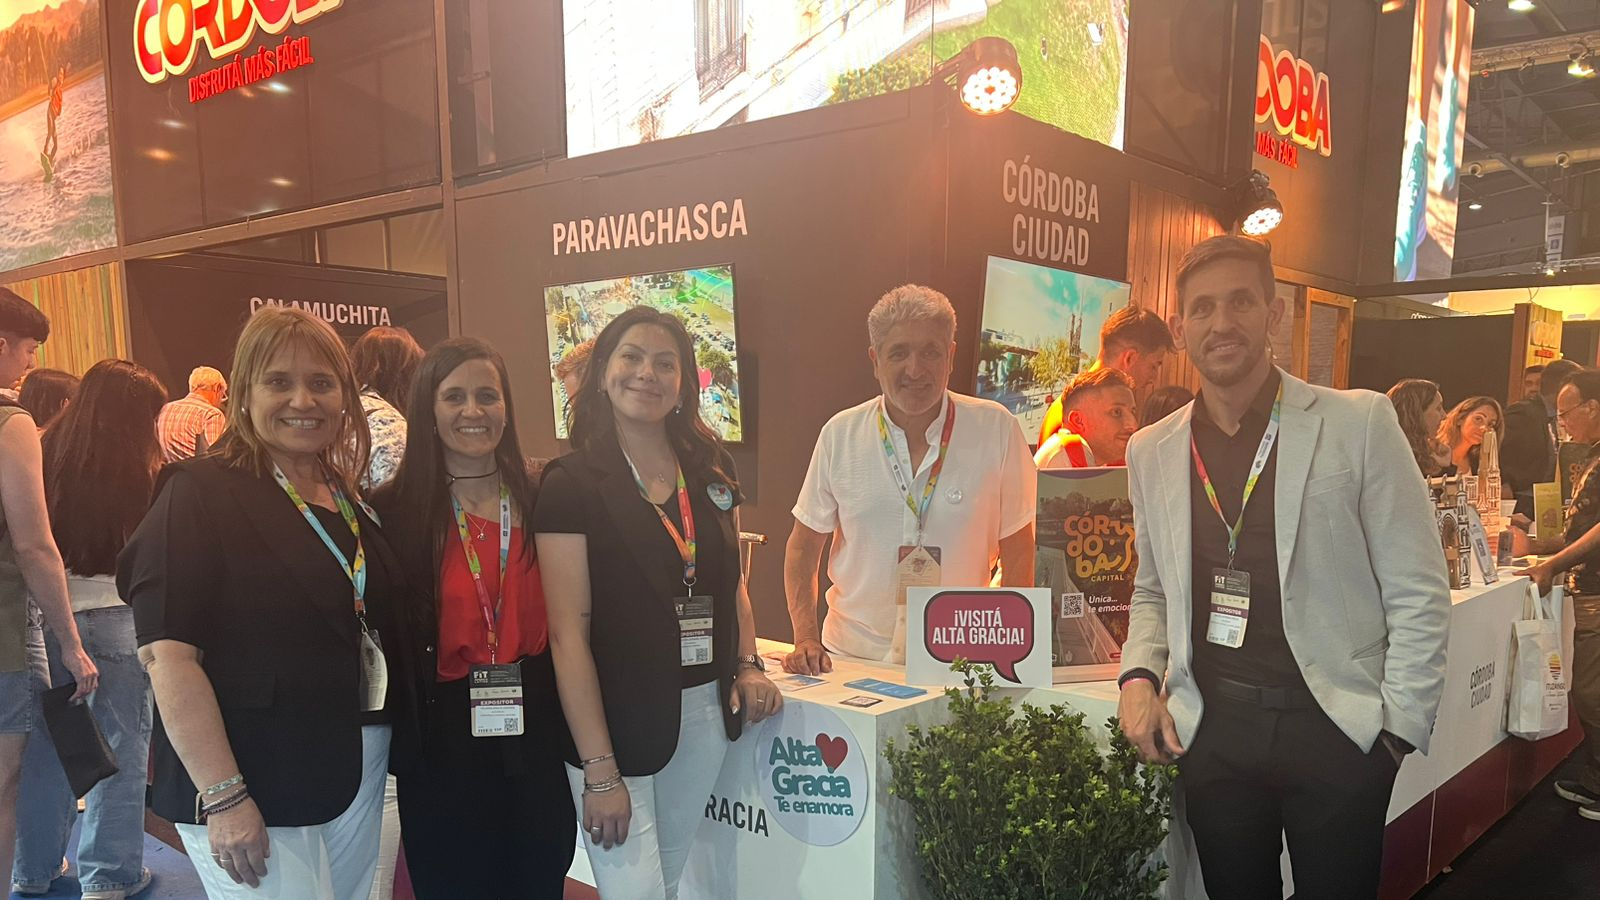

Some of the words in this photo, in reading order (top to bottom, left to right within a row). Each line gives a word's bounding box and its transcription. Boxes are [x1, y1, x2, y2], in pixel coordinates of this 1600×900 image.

[188, 54, 244, 103] DISFRUTÁ
[244, 46, 275, 84] MÁS
[1256, 130, 1276, 160] MÁS
[1003, 154, 1099, 223] CÓRDOBA
[552, 198, 748, 256] PARAVACHASCA
[1012, 213, 1089, 266] CIUDAD
[954, 607, 1002, 627] ¡VISITÁ
[932, 627, 966, 645] ALTA
[969, 627, 1025, 645] GRACIA!
[1470, 661, 1495, 690] CÓRDOBA
[1471, 682, 1491, 709] CIUDAD
[769, 736, 823, 766] Alta
[771, 766, 851, 798] Gracia
[773, 796, 790, 812] Te
[793, 800, 854, 816] enamora
